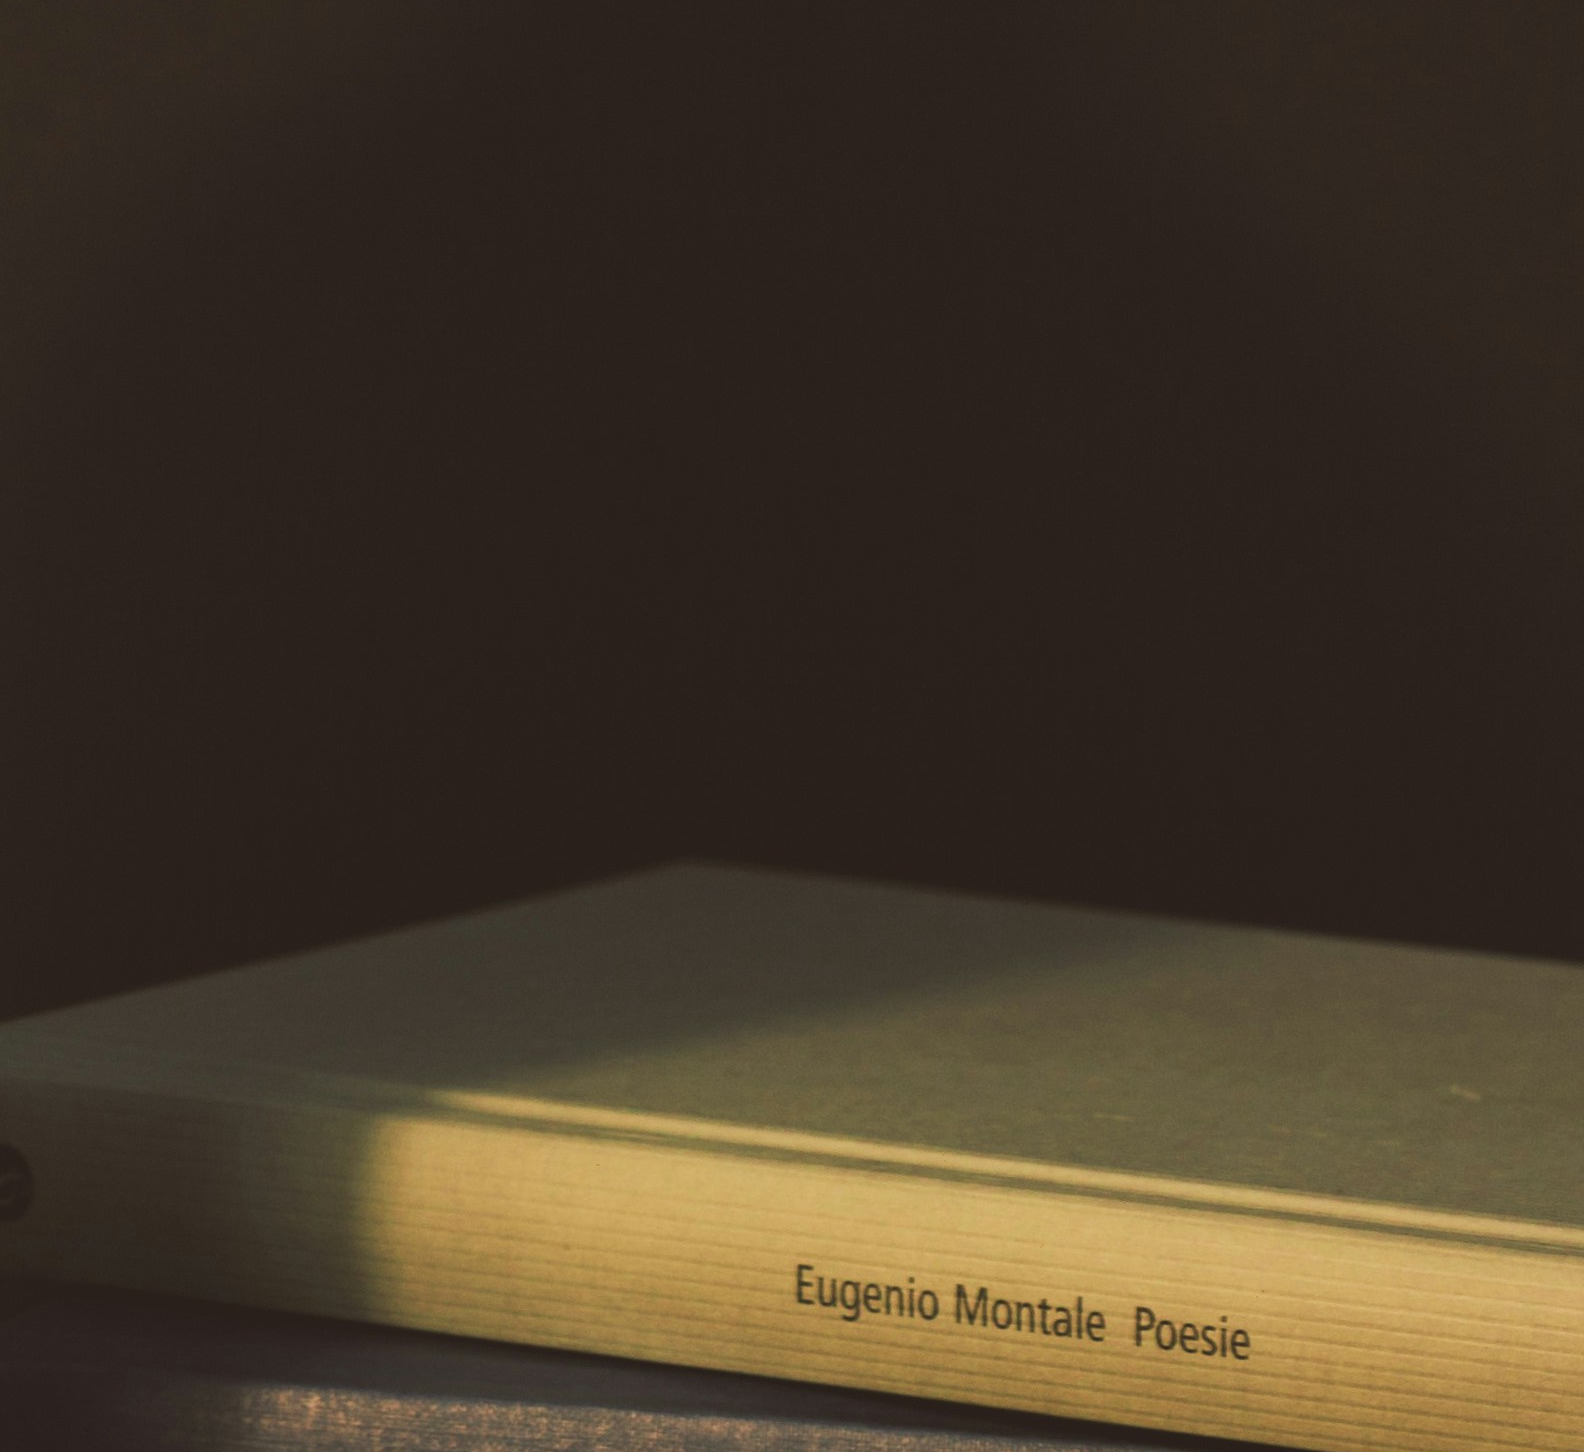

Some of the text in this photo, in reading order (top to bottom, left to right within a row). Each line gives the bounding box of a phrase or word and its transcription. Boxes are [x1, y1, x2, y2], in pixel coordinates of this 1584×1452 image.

[795, 1263, 1252, 1360] Eugenio Montale Poesie
